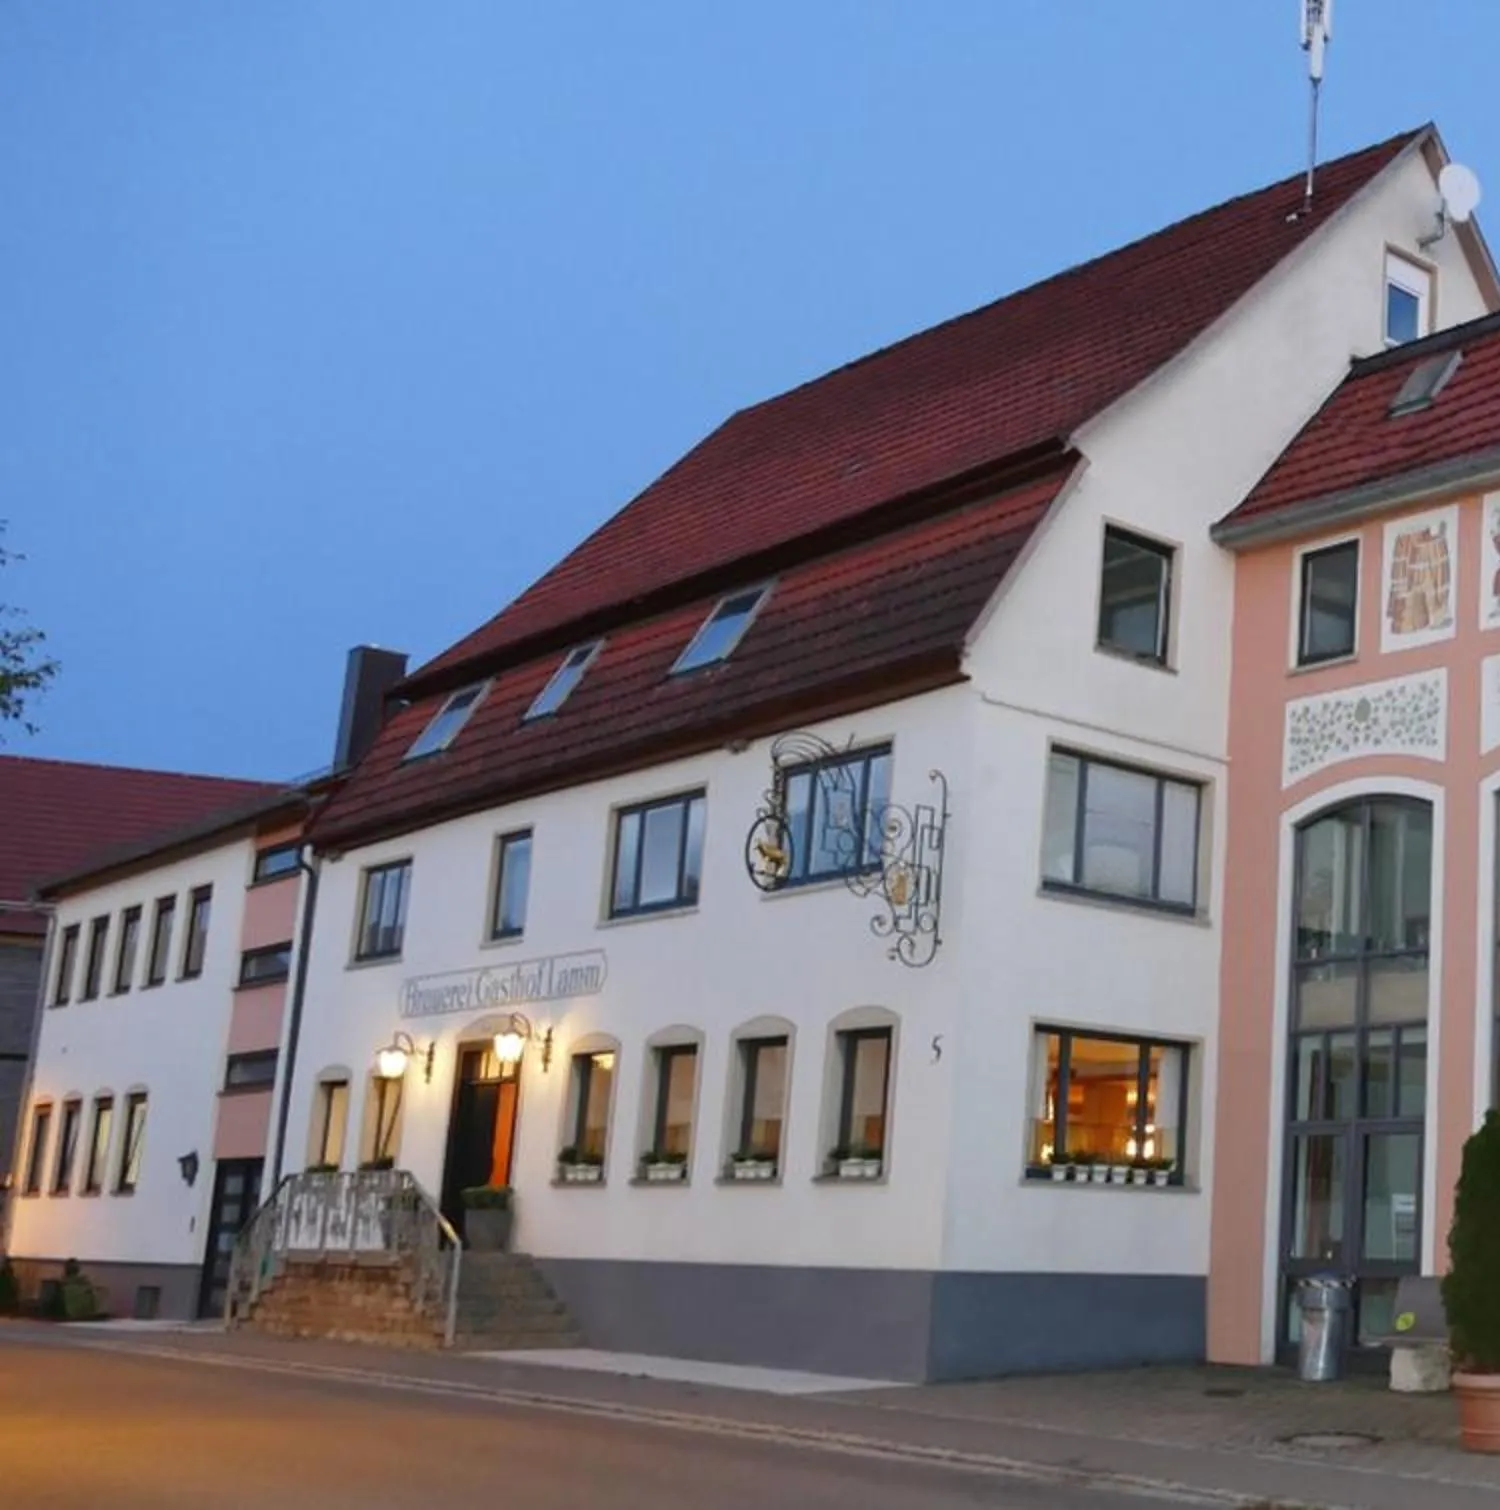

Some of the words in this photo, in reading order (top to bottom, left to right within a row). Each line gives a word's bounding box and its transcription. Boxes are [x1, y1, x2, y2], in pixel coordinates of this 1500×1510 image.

[404, 976, 472, 1014] Brauerei
[476, 959, 546, 1003] Gasthof
[548, 956, 601, 998] Lamm
